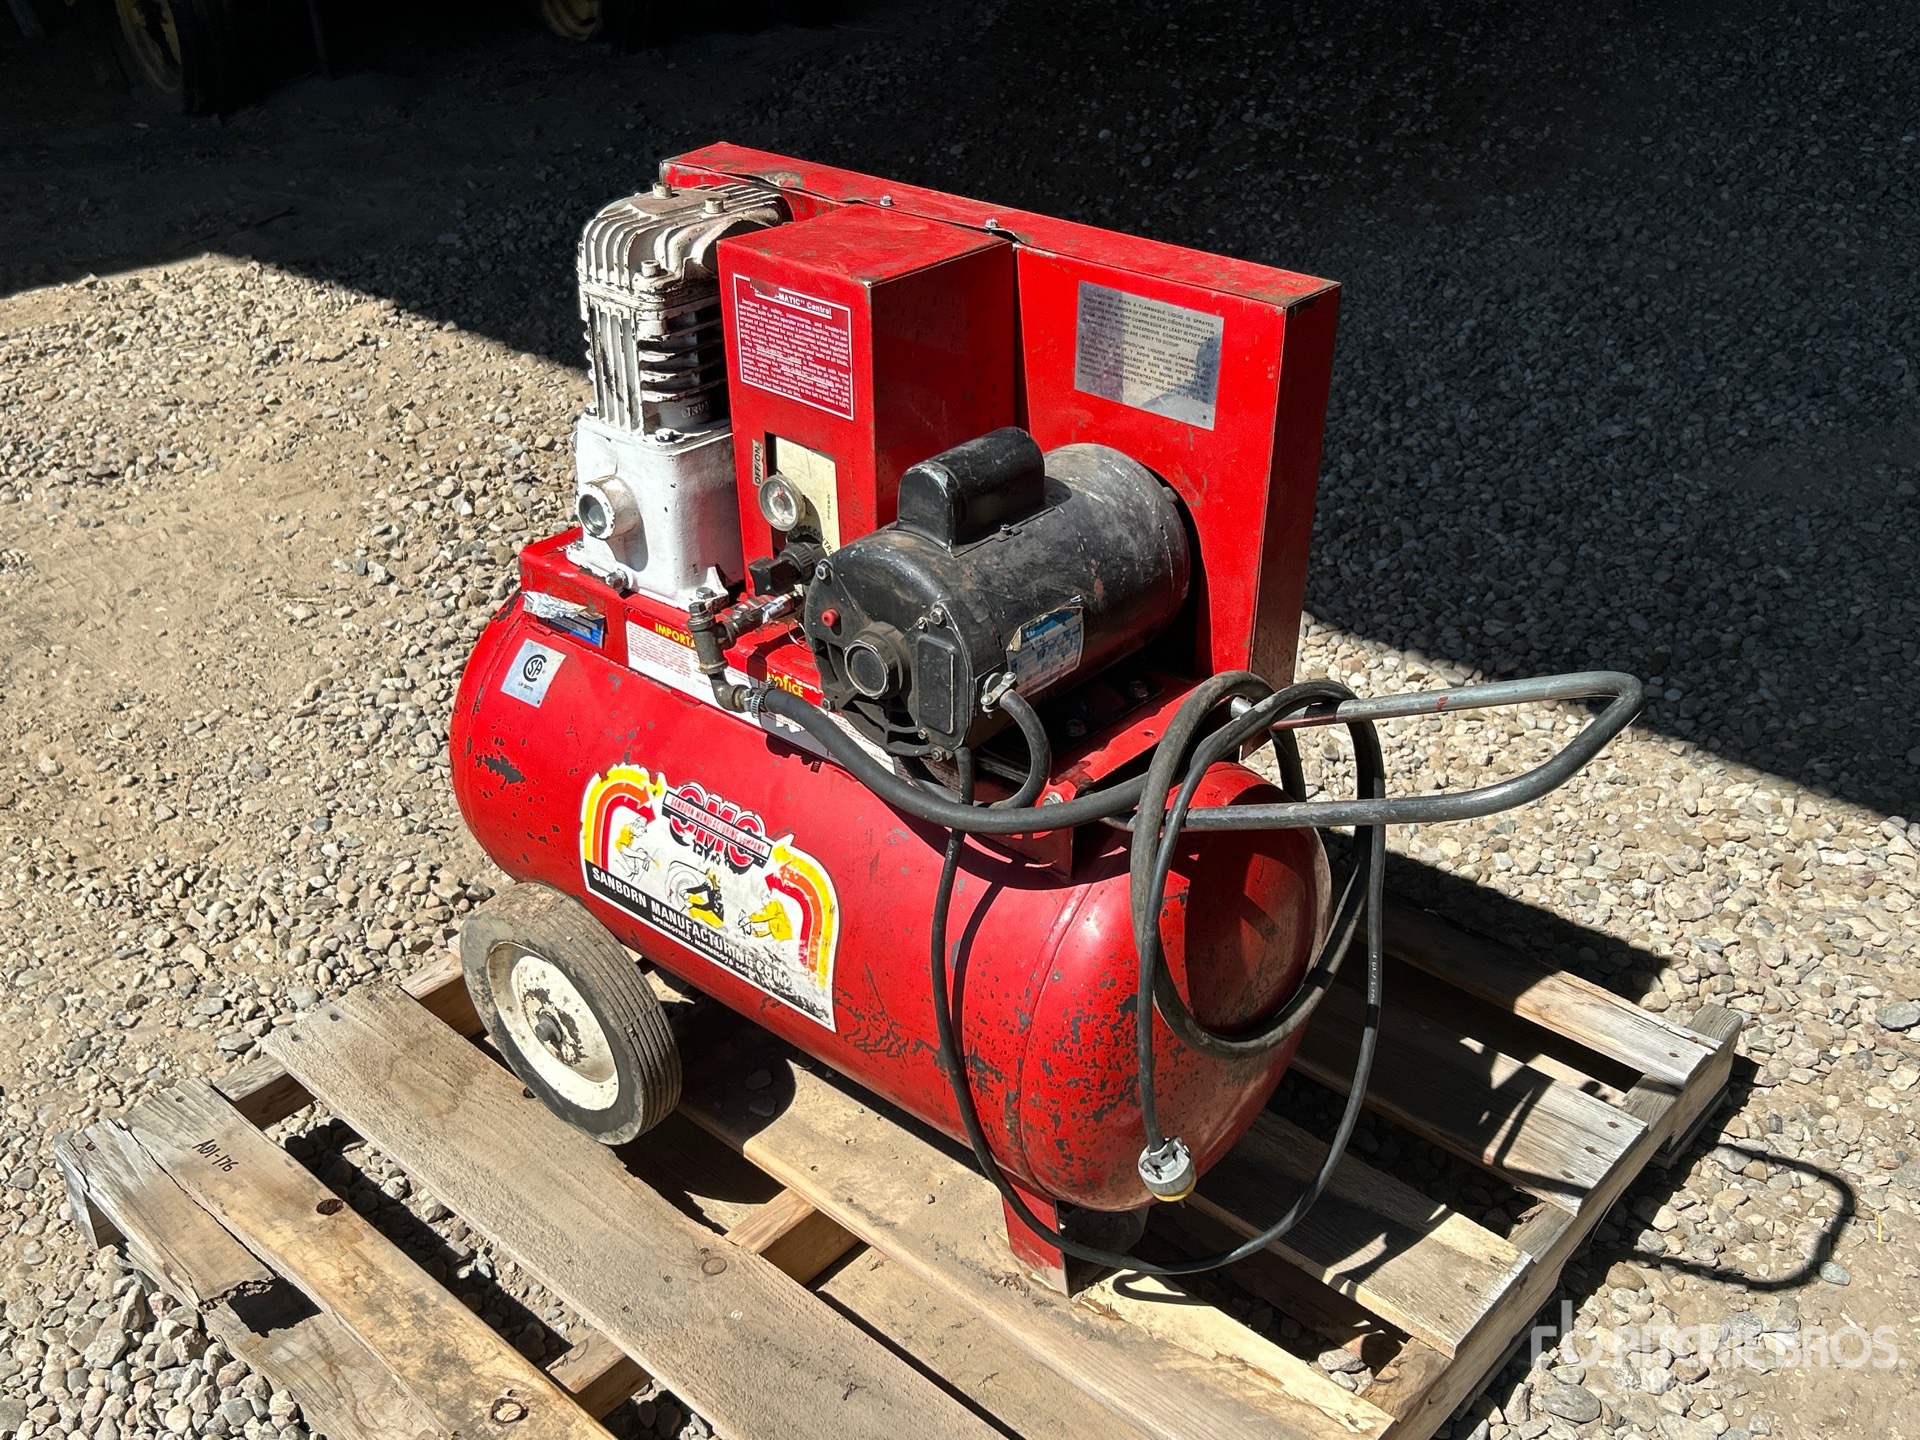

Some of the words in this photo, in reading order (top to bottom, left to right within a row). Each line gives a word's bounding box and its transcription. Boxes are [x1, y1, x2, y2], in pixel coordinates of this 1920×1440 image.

[806, 300, 831, 315] Control
[1138, 303, 1165, 315] FLAMMABLE
[1168, 311, 1183, 320] LIQUID
[1193, 317, 1214, 328] SPRAYED
[1131, 316, 1161, 329] COMPRESSOR
[1168, 326, 1182, 334] LEAST
[1132, 323, 1159, 335] HAZARDOUS
[1182, 322, 1208, 333] ESPECIALLY
[1139, 332, 1154, 341] LIKELY
[655, 621, 696, 649] IMPORTA
[670, 797, 695, 815] SANBORN
[695, 809, 739, 841] MANUFACTURING
[592, 867, 647, 907] SANBORN
[651, 899, 754, 969] MANUFACTURING
